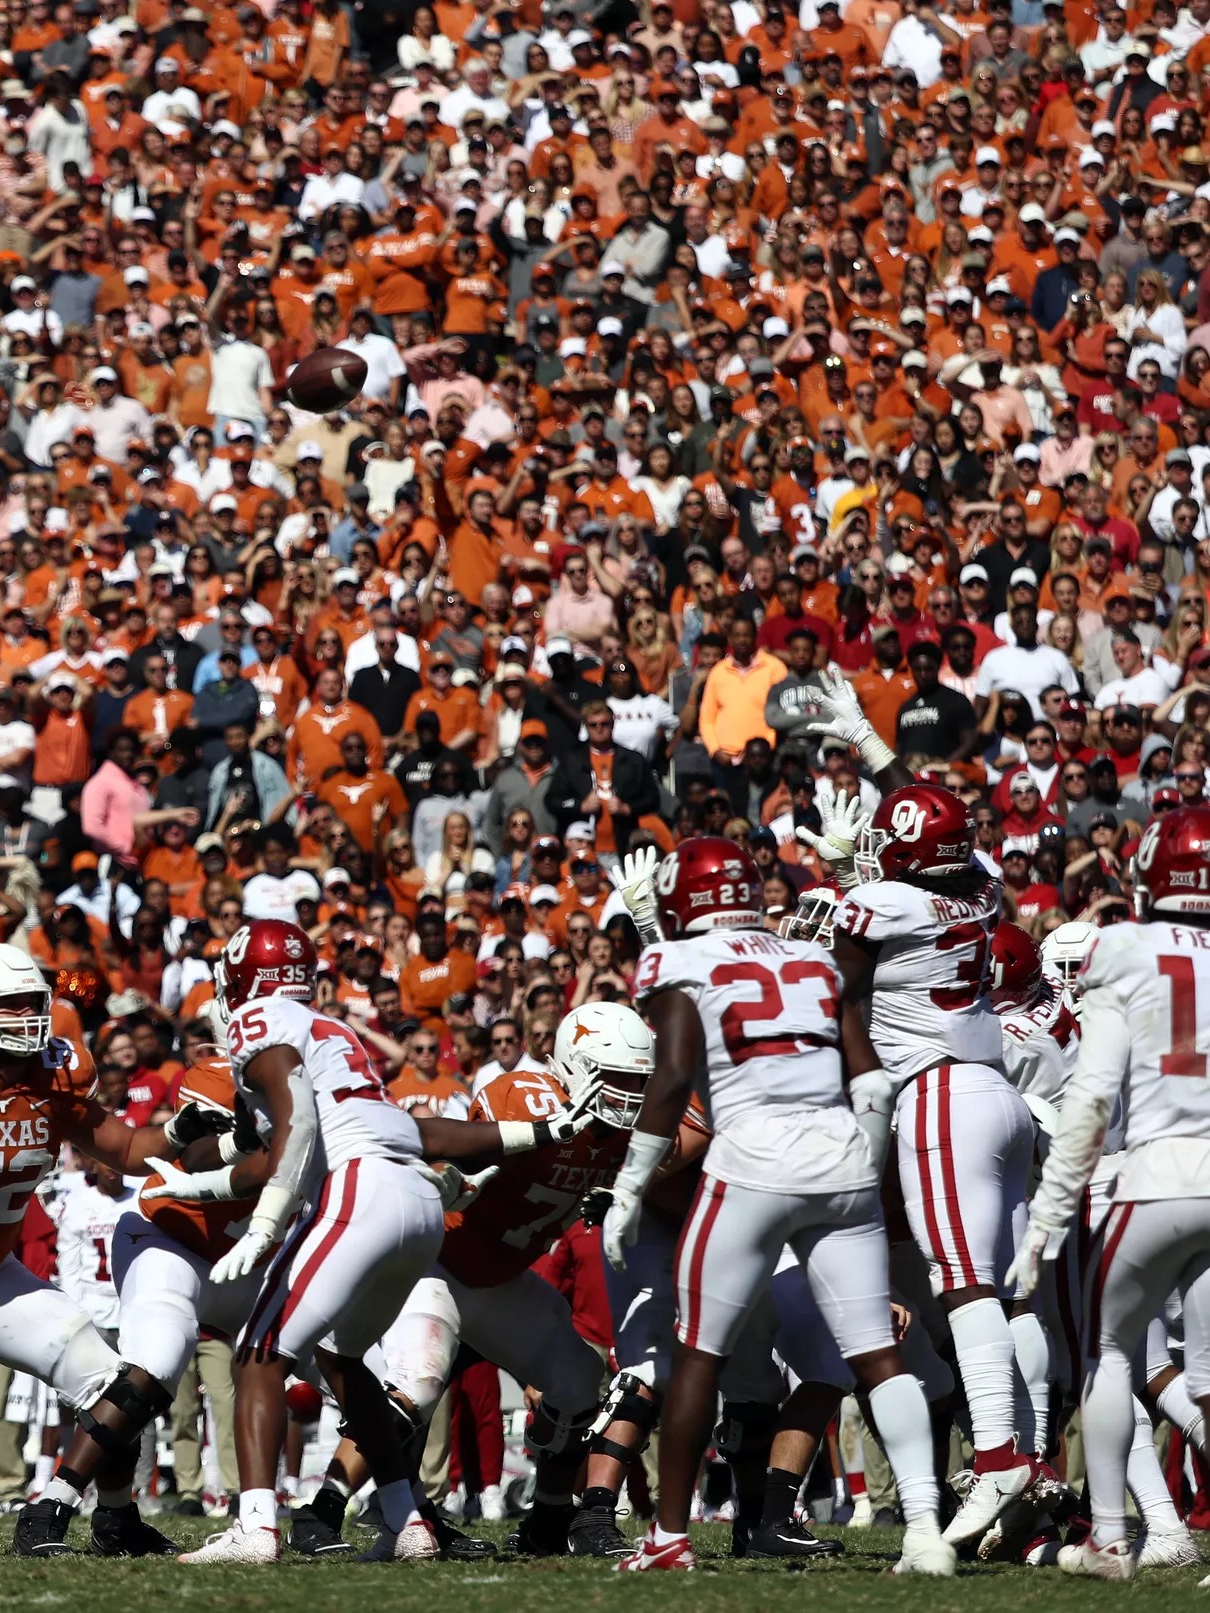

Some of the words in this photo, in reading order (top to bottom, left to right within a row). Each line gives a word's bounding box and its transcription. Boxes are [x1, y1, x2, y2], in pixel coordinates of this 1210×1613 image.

[891, 800, 926, 842] OU
[719, 882, 750, 905] 23
[845, 902, 874, 936] 31
[723, 936, 795, 956] WHITE
[282, 964, 307, 983] 35
[710, 960, 840, 1066] 23
[226, 1006, 268, 1057] 35
